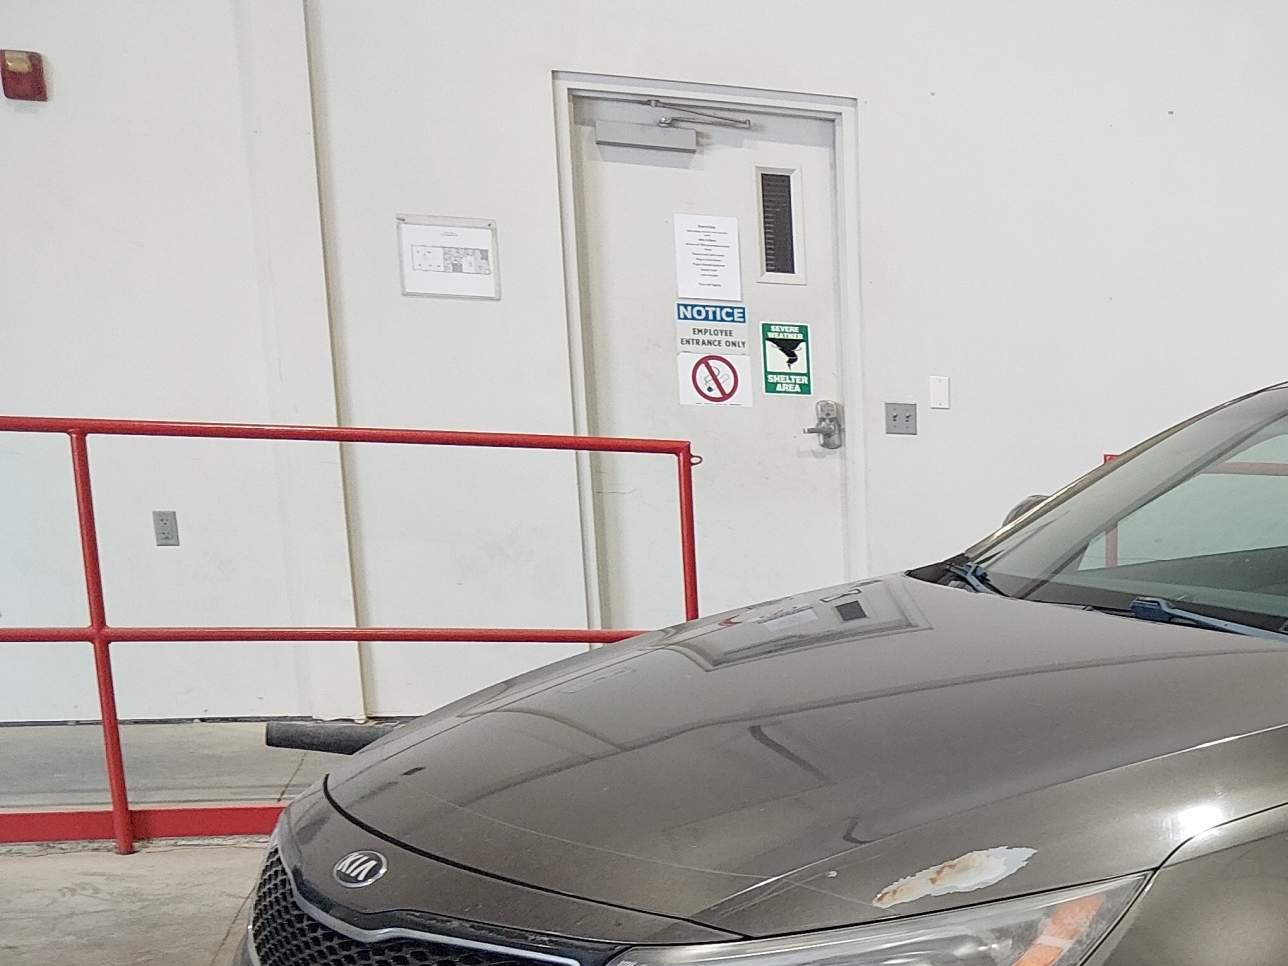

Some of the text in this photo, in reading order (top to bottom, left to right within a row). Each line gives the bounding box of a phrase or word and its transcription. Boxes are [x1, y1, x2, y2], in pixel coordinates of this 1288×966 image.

[679, 305, 745, 322] NOTICE
[692, 328, 734, 337] EMPLOYEE
[770, 325, 800, 333] SEVERE
[767, 332, 803, 340] WEATHER
[680, 338, 746, 349] ENTRANCE ONLY
[767, 375, 809, 385] SHELTER
[776, 383, 802, 393] AREA
